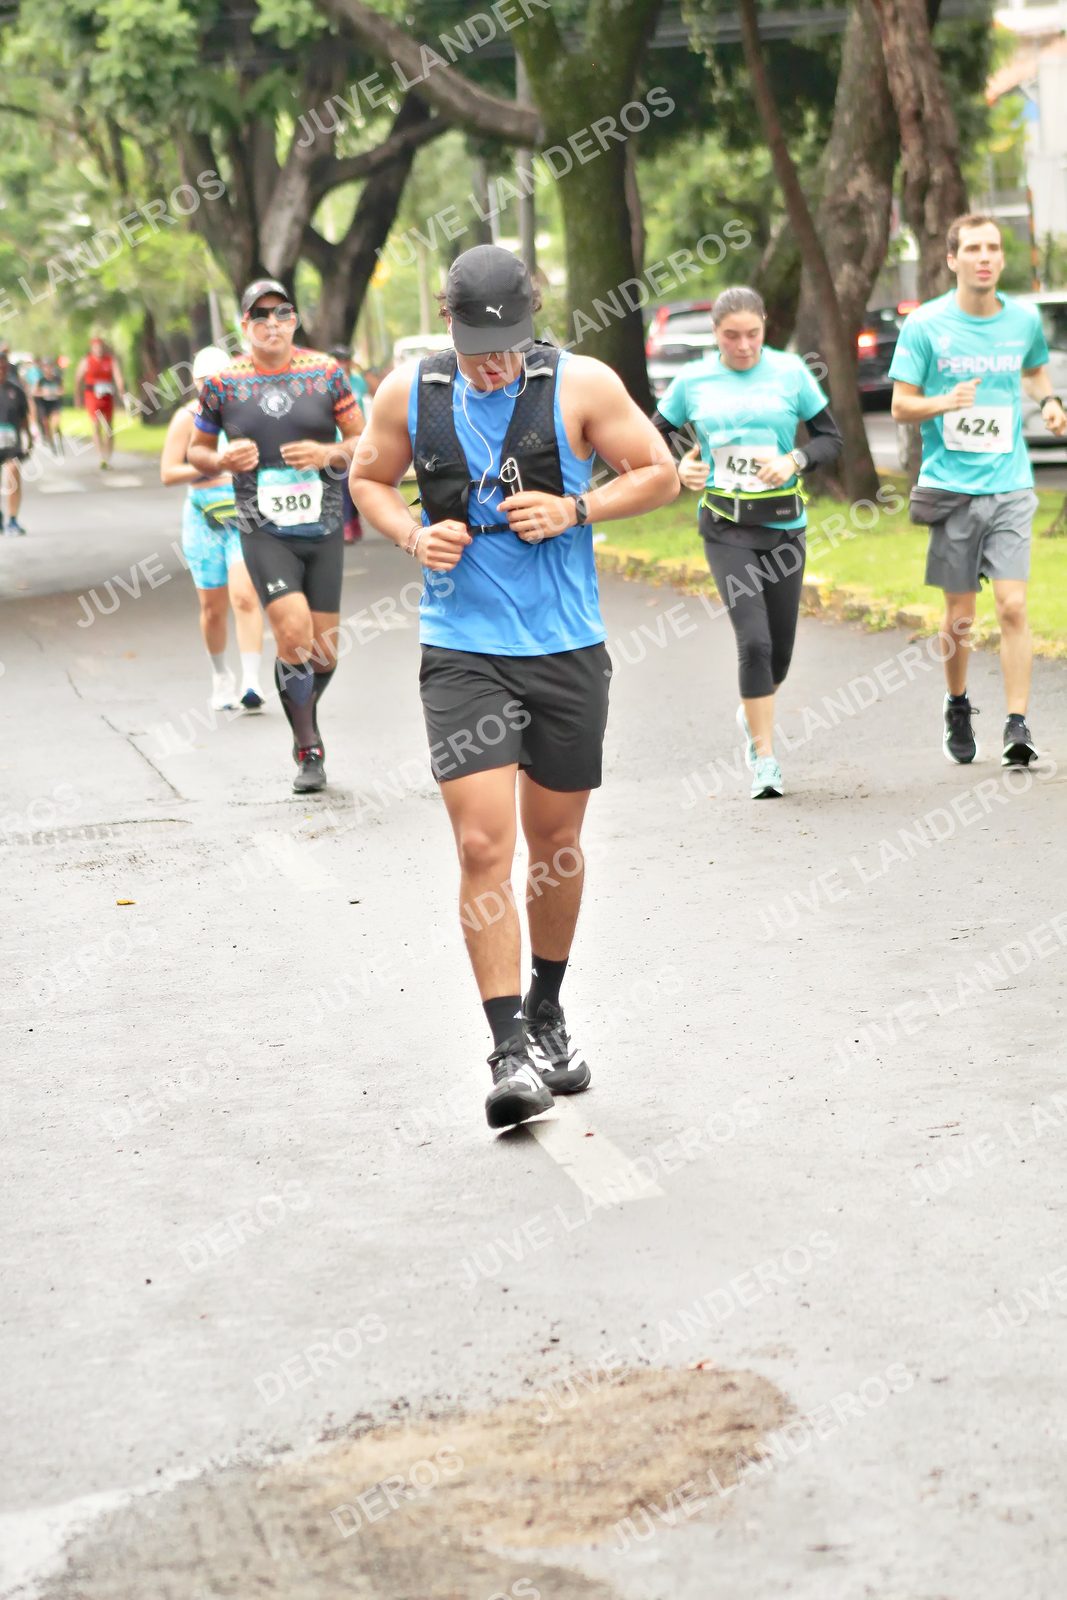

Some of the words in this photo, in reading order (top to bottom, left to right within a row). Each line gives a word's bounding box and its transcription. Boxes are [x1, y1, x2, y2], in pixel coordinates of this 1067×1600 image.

[956, 417, 1000, 437] 424
[726, 456, 761, 475] 425
[271, 494, 311, 512] 380
